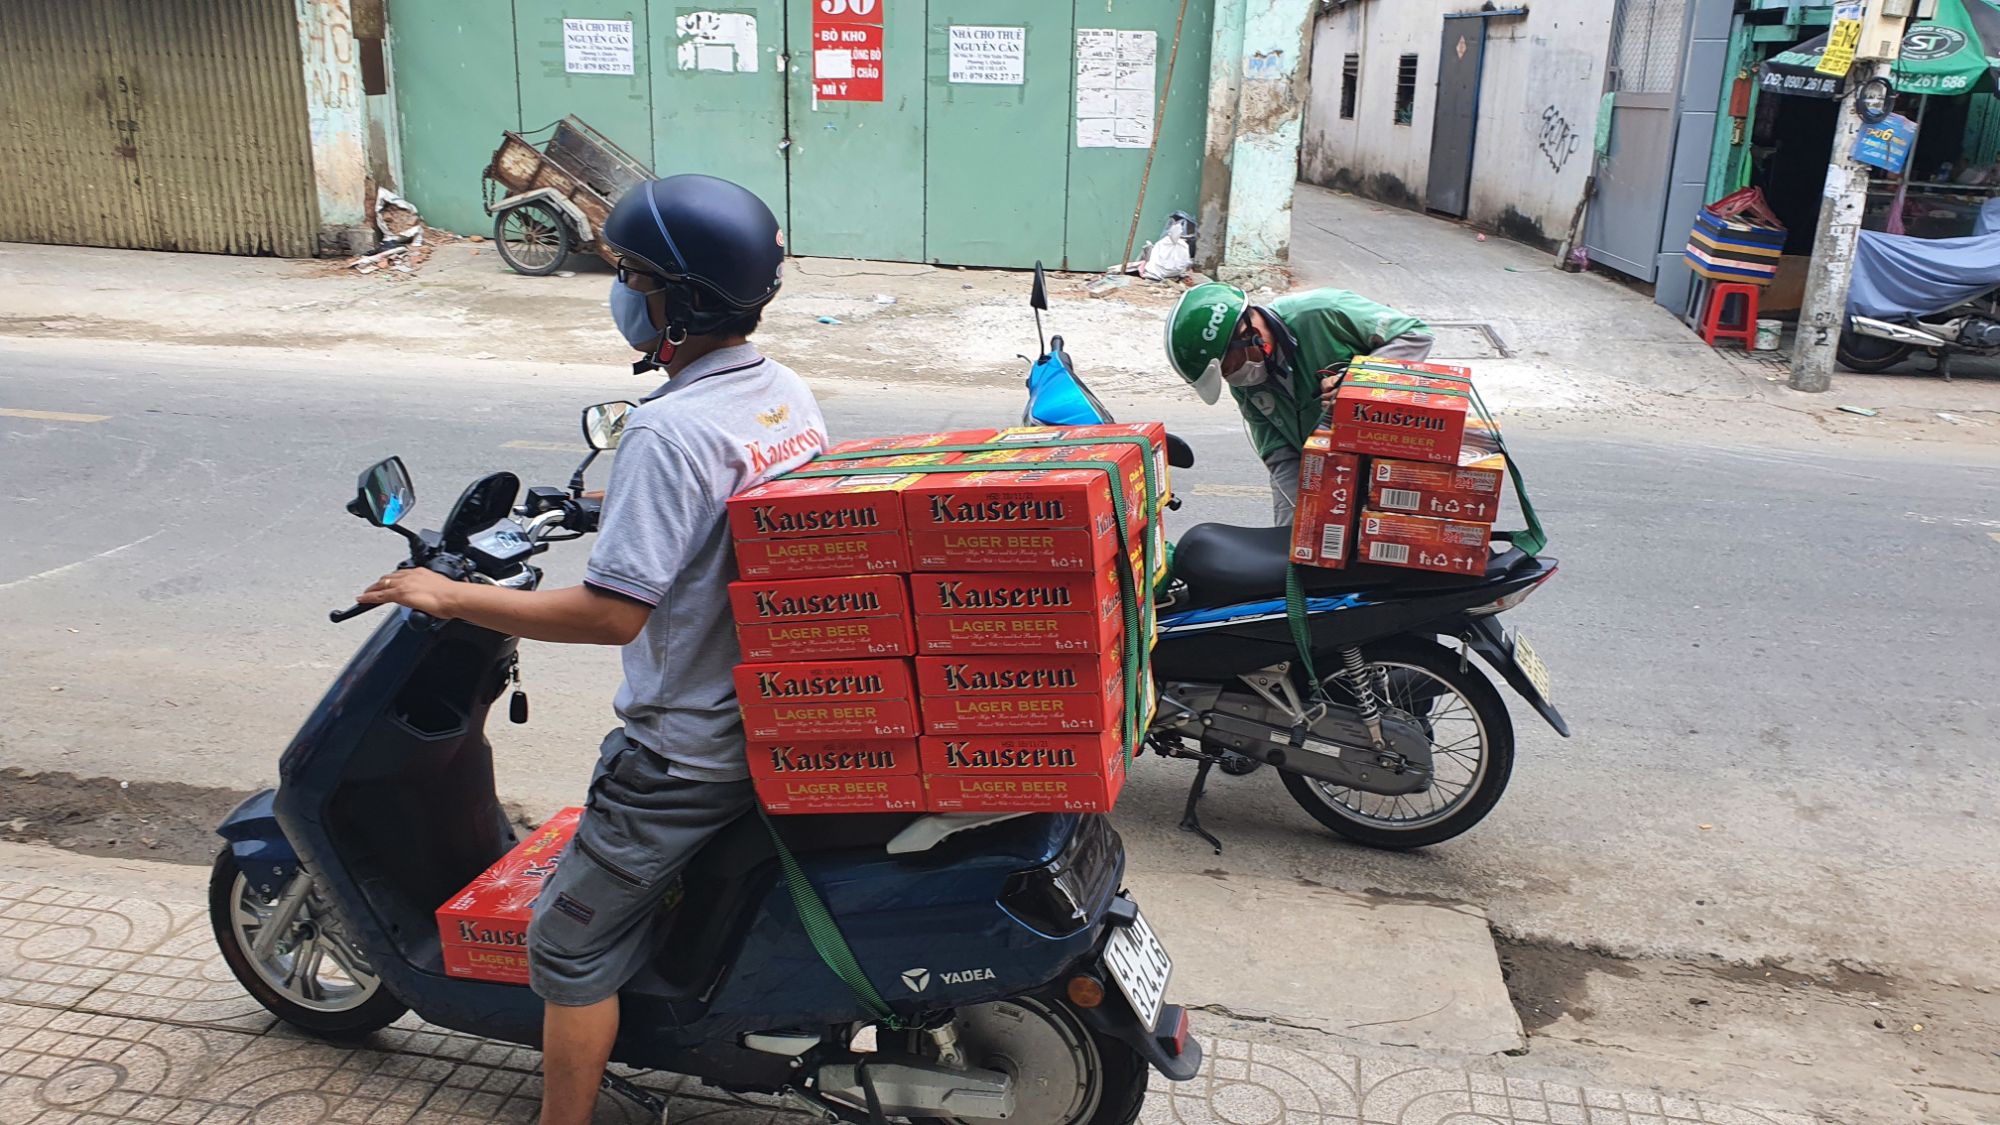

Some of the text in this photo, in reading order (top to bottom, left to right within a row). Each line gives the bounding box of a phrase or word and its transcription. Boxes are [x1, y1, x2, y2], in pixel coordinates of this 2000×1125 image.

[566, 21, 584, 31] NHÀ
[586, 23, 606, 32] CHO
[821, 28, 867, 42] BÒ KHO
[952, 28, 1022, 40] NHÀ CHO THUÊ
[1907, 35, 1945, 50] ST
[822, 82, 836, 95] MÌ
[1202, 302, 1228, 341] Grab
[1352, 402, 1447, 432] Kaiserin
[1357, 430, 1399, 444] LAGER
[1402, 436, 1436, 448] BEER
[744, 426, 822, 475] Kaiserin
[927, 494, 1067, 524] Kaiserin
[750, 505, 881, 534] Kaiserin
[766, 541, 868, 558] LAGER BEER
[944, 535, 1054, 548] LAGER BEER
[936, 580, 1073, 609] Kaiserin
[753, 590, 882, 618] Kaiserin
[768, 624, 870, 642] LAGER BEER
[950, 619, 1059, 632] LAGER BEER
[756, 671, 886, 700] Kaiserin
[942, 664, 1079, 692] Kaiserin
[774, 707, 877, 721] LAGER BEER
[955, 700, 1064, 714] LAGER BEER
[769, 746, 896, 774] Kaiserin
[944, 741, 1078, 769] Kaiserin
[786, 782, 888, 795] LAGER BEER
[960, 780, 1069, 792] LAGER BEER
[458, 920, 528, 946] Kaise
[468, 951, 515, 966] LAGER
[939, 968, 996, 984] YADEA
[1132, 938, 1168, 1020] 324.46
